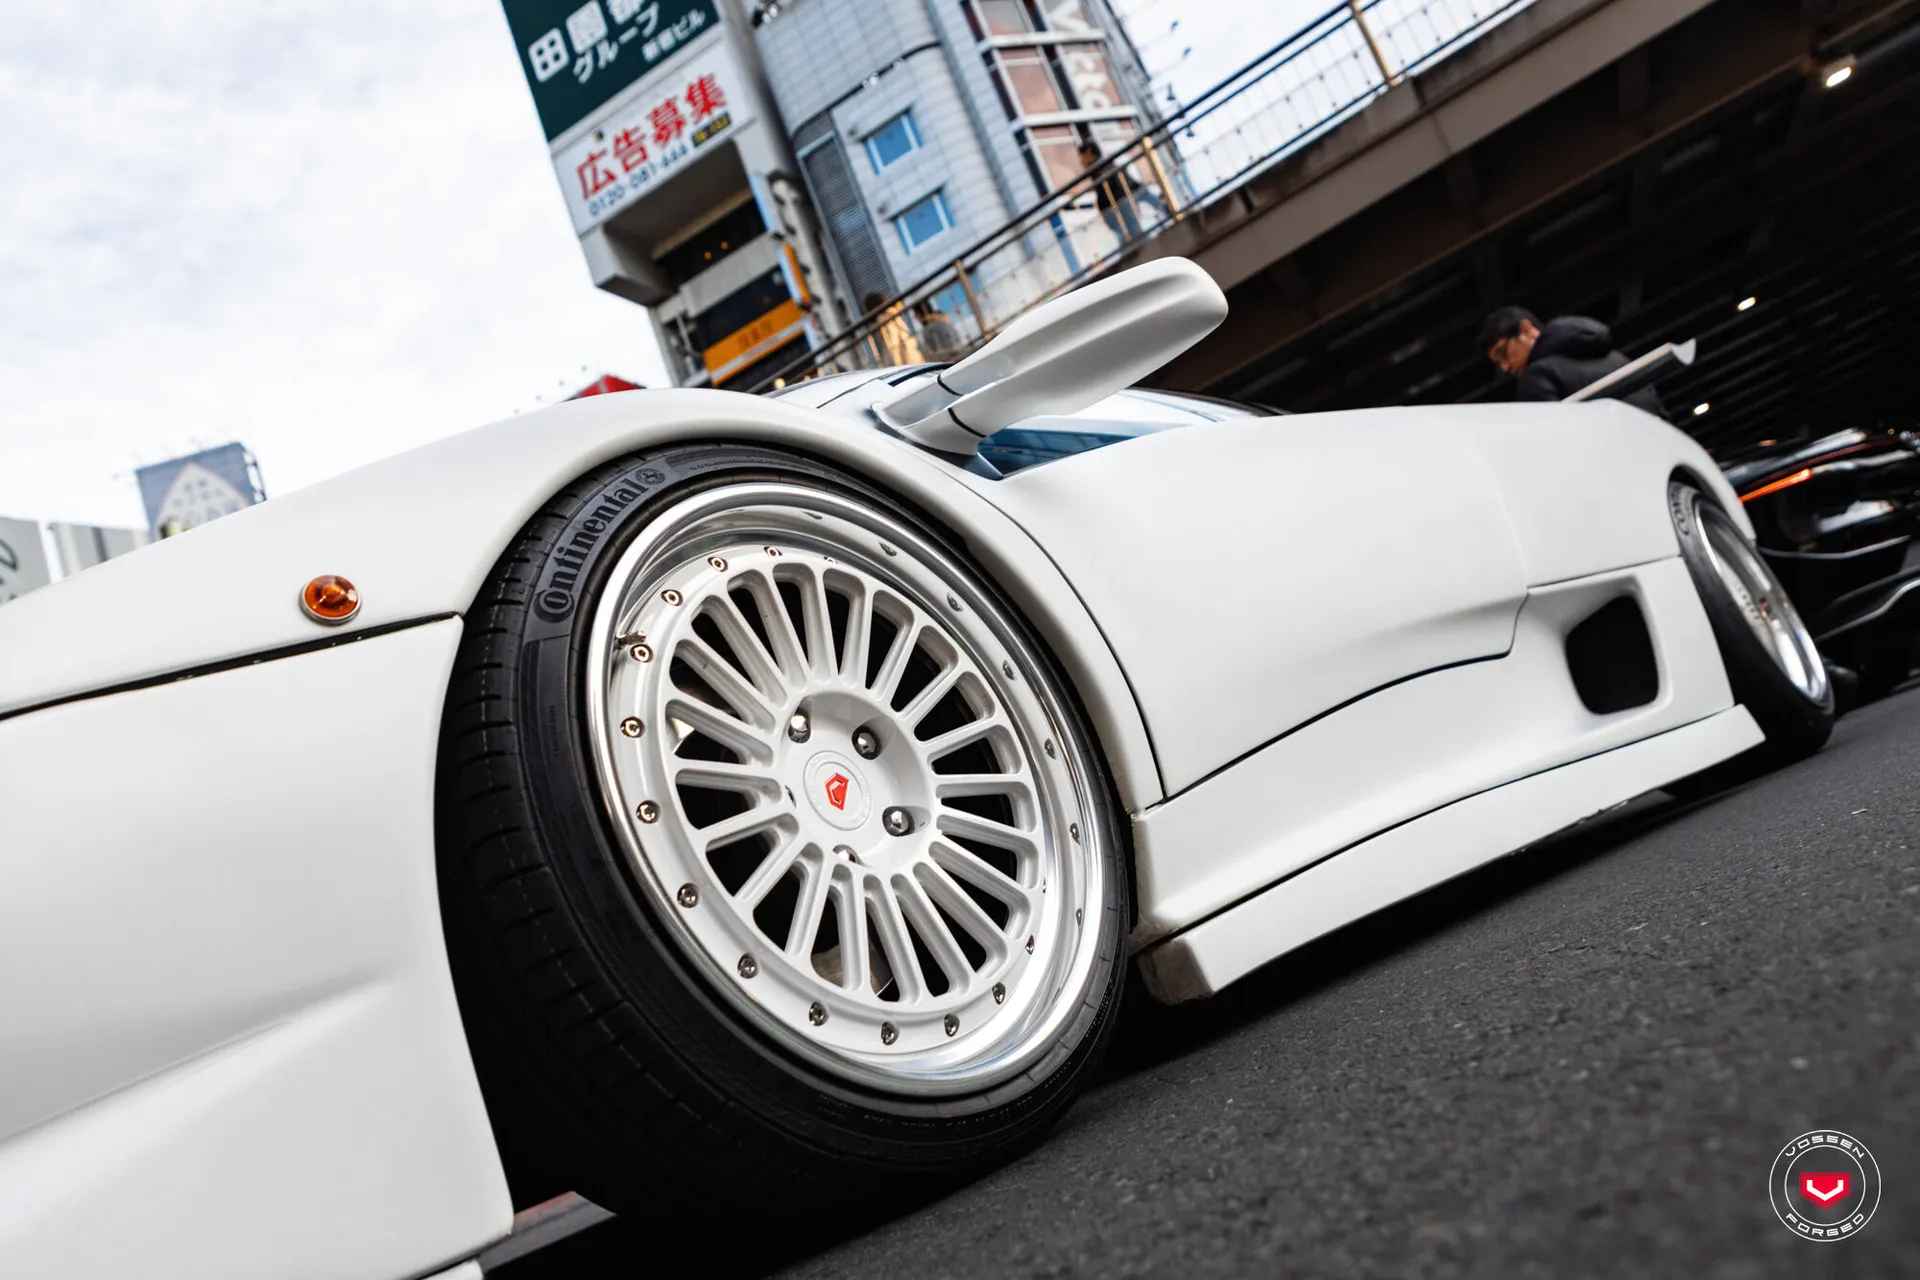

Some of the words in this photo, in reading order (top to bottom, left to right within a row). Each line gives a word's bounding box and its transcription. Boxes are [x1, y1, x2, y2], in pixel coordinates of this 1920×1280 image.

[576, 73, 727, 200] 広告募集
[533, 479, 649, 623] Continental
